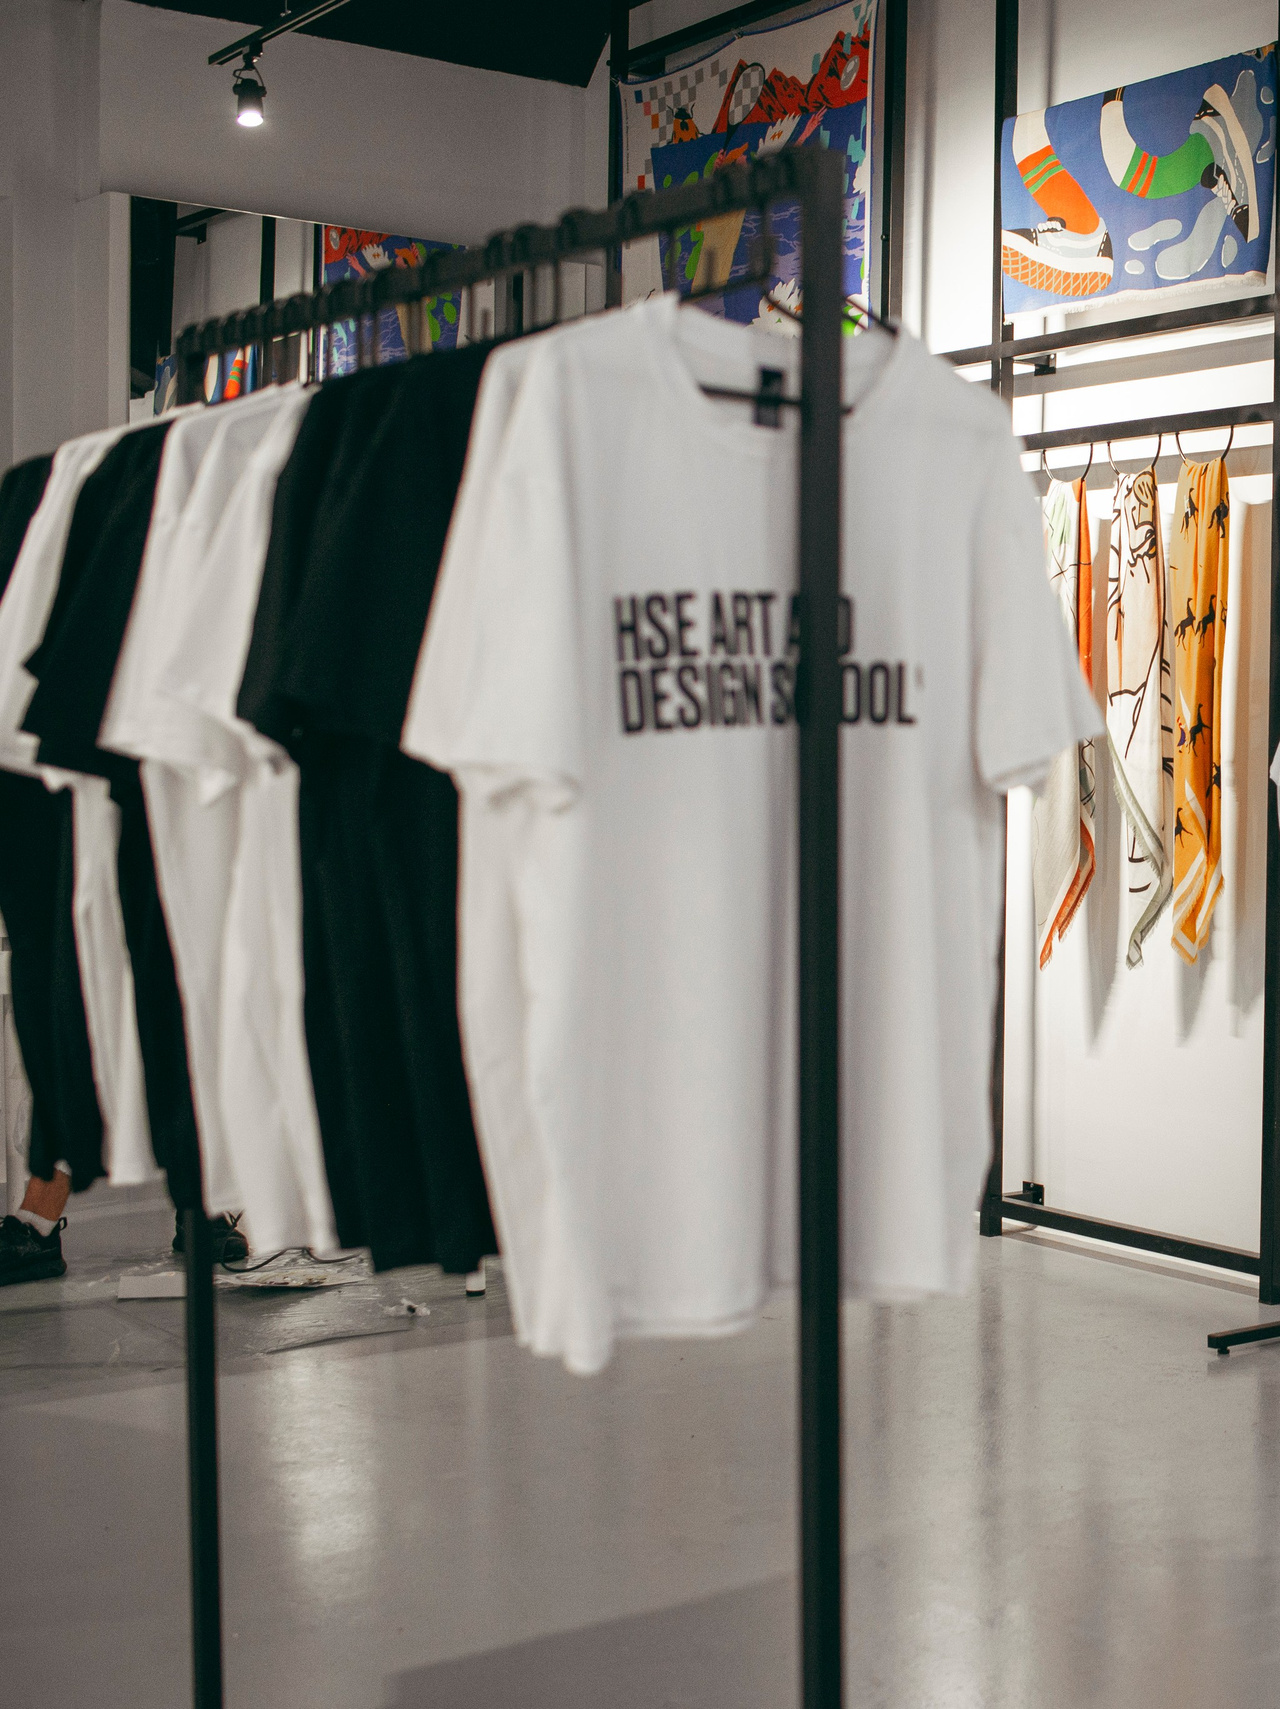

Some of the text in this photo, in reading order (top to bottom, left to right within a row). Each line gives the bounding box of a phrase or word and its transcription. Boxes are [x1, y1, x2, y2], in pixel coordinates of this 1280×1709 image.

[612, 590, 856, 662] HSE ART AD
[619, 661, 764, 736] DESIGN
